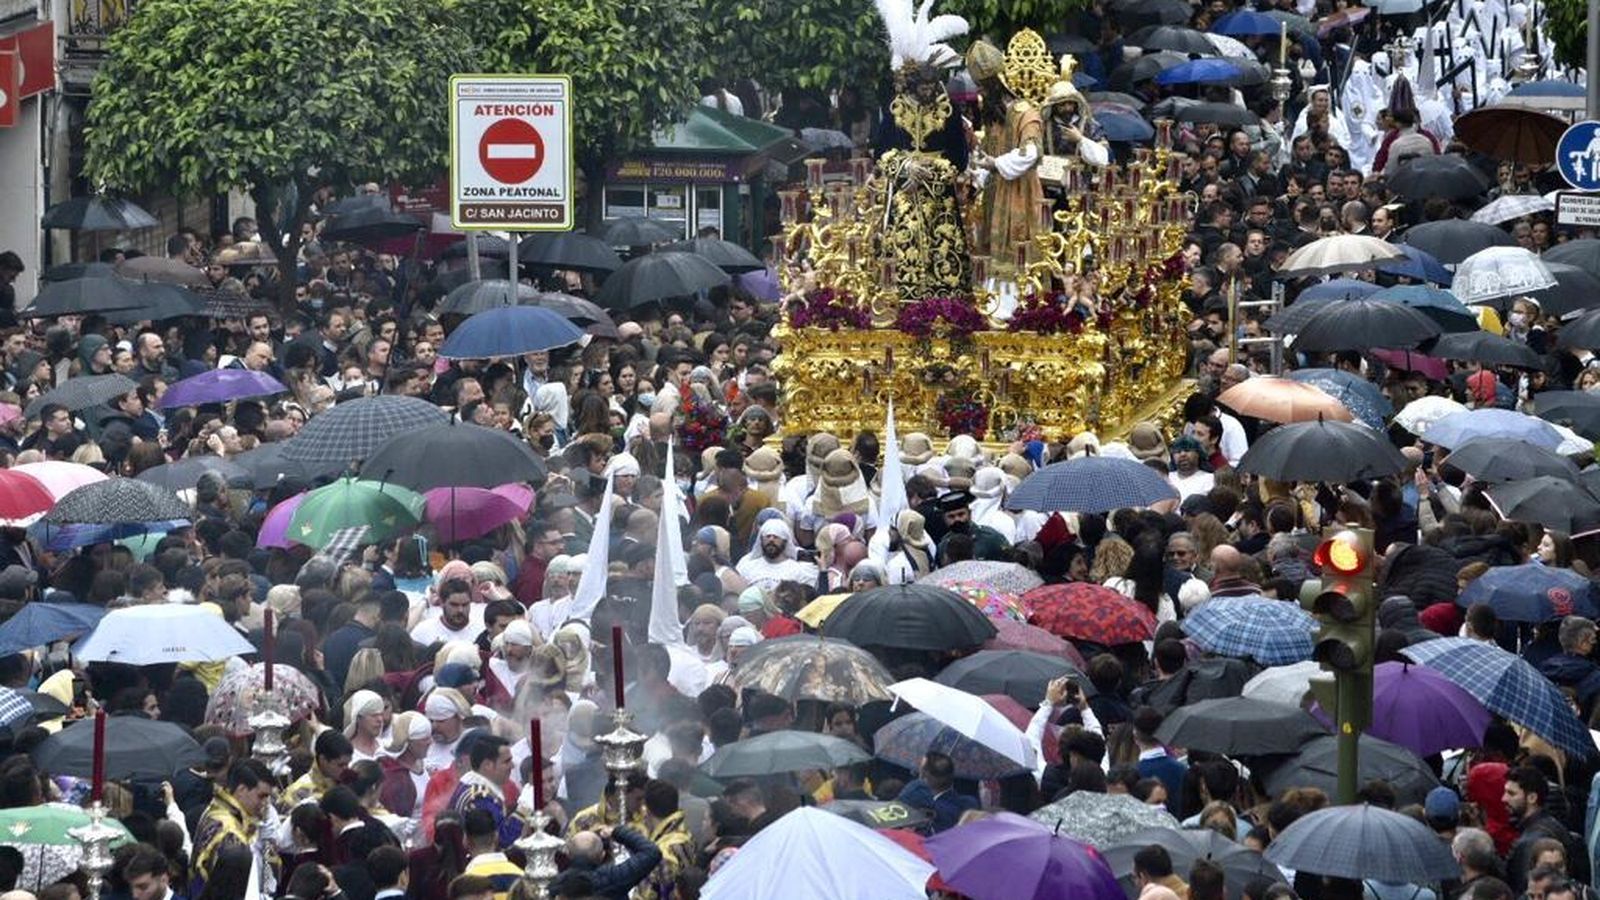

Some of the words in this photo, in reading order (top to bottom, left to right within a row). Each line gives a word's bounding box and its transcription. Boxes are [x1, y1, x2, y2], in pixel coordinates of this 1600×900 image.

[474, 103, 554, 116] ATENCIÓN
[463, 187, 496, 197] ZONA
[499, 187, 560, 197] PEATONAL
[465, 208, 477, 219] C/
[480, 208, 505, 219] SAN
[507, 208, 559, 219] JACINTO
